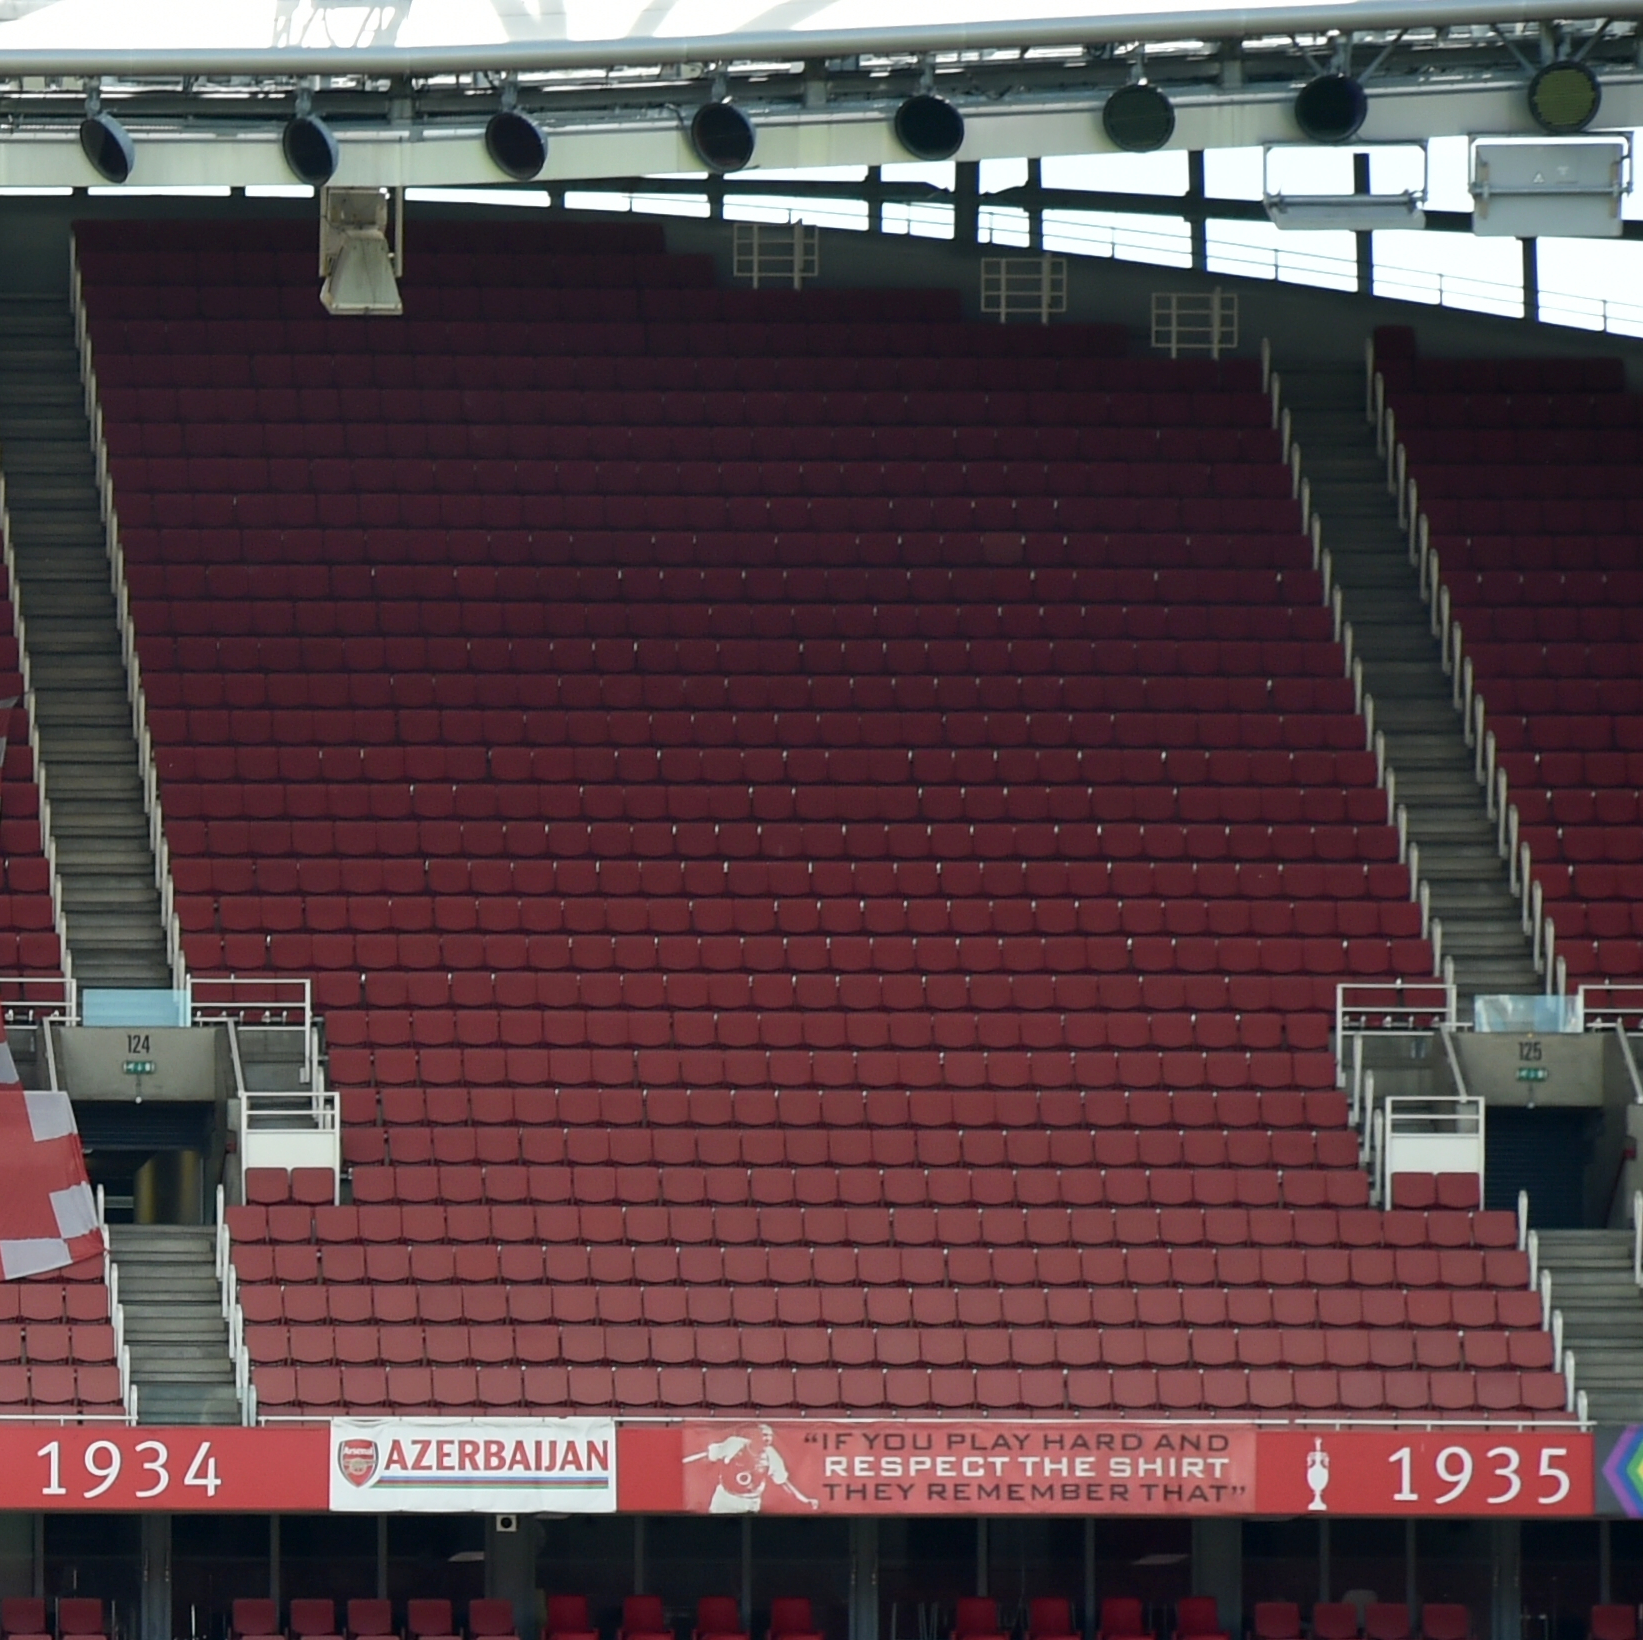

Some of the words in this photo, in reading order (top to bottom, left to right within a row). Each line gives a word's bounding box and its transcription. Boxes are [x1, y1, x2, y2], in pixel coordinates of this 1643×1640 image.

[127, 1034, 150, 1054] 124
[1518, 1041, 1543, 1061] 125
[862, 1433, 933, 1451] YOU
[947, 1433, 1031, 1451] PLAY
[1043, 1433, 1143, 1451] HARD
[1154, 1434, 1230, 1452] AND
[384, 1439, 609, 1471] AZERBAIJAN
[37, 1441, 222, 1497] 1934
[825, 1456, 1010, 1477] RESPECT
[1014, 1456, 1096, 1477] THE
[1109, 1457, 1230, 1477] SHIRT
[1389, 1446, 1571, 1505] 1935
[822, 1483, 915, 1501] THEY
[926, 1483, 1130, 1501] REMEMBER
